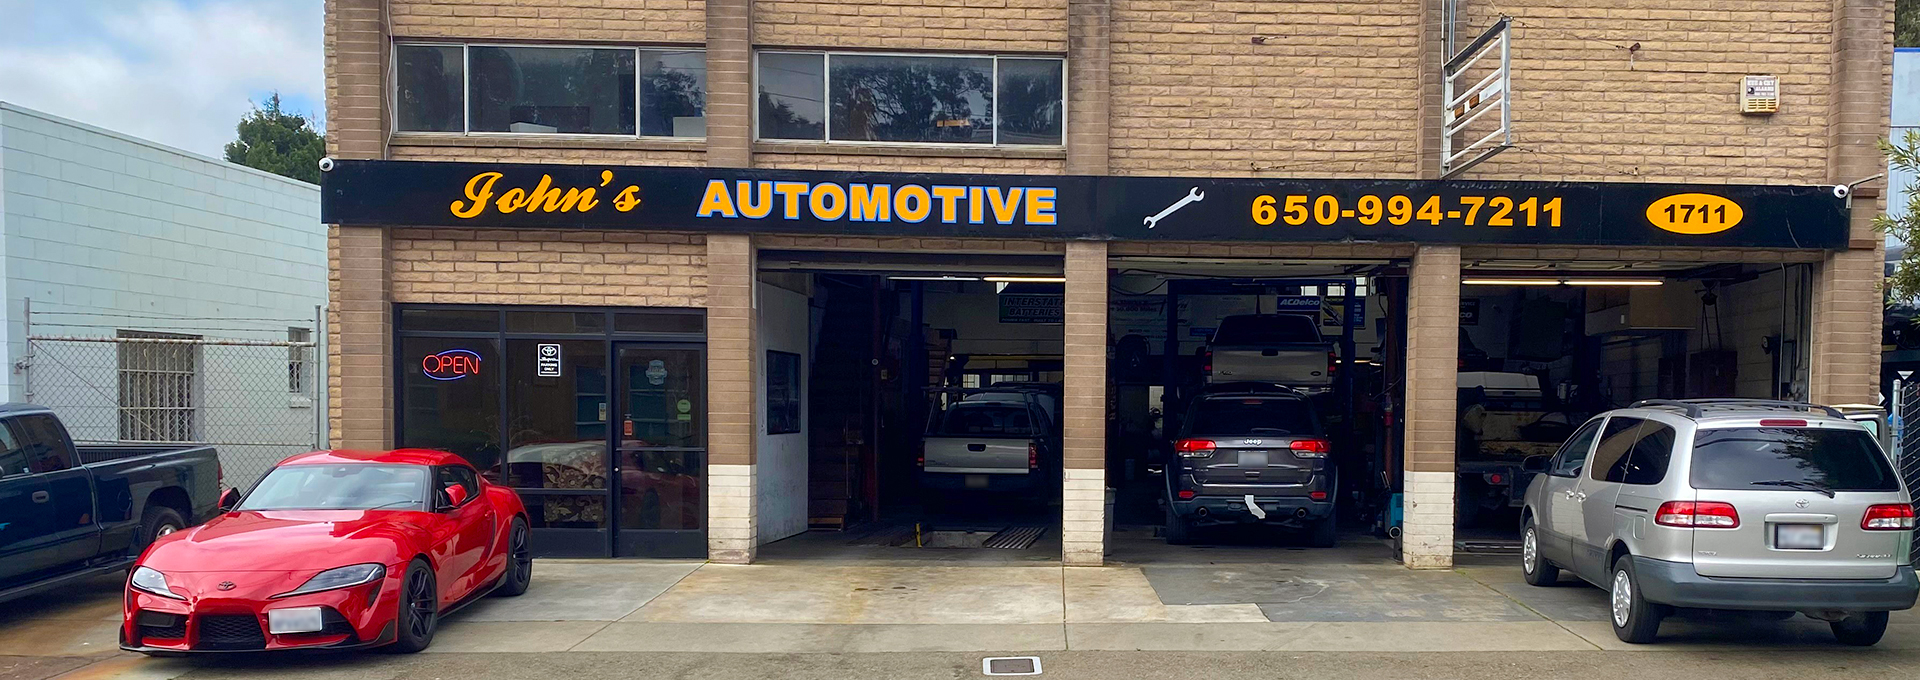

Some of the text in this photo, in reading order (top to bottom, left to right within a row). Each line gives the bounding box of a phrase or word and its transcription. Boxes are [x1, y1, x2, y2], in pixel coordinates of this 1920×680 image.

[450, 169, 641, 219] John's
[697, 179, 1058, 226] AUTOMOTIVE
[1251, 194, 1562, 228] 650-994-7211
[1664, 204, 1725, 224] 1711
[1008, 307, 1061, 316] BATTERIES
[1280, 298, 1320, 306] ACDelco
[422, 354, 480, 375] OPEN
[1244, 438, 1263, 446] Jeep
